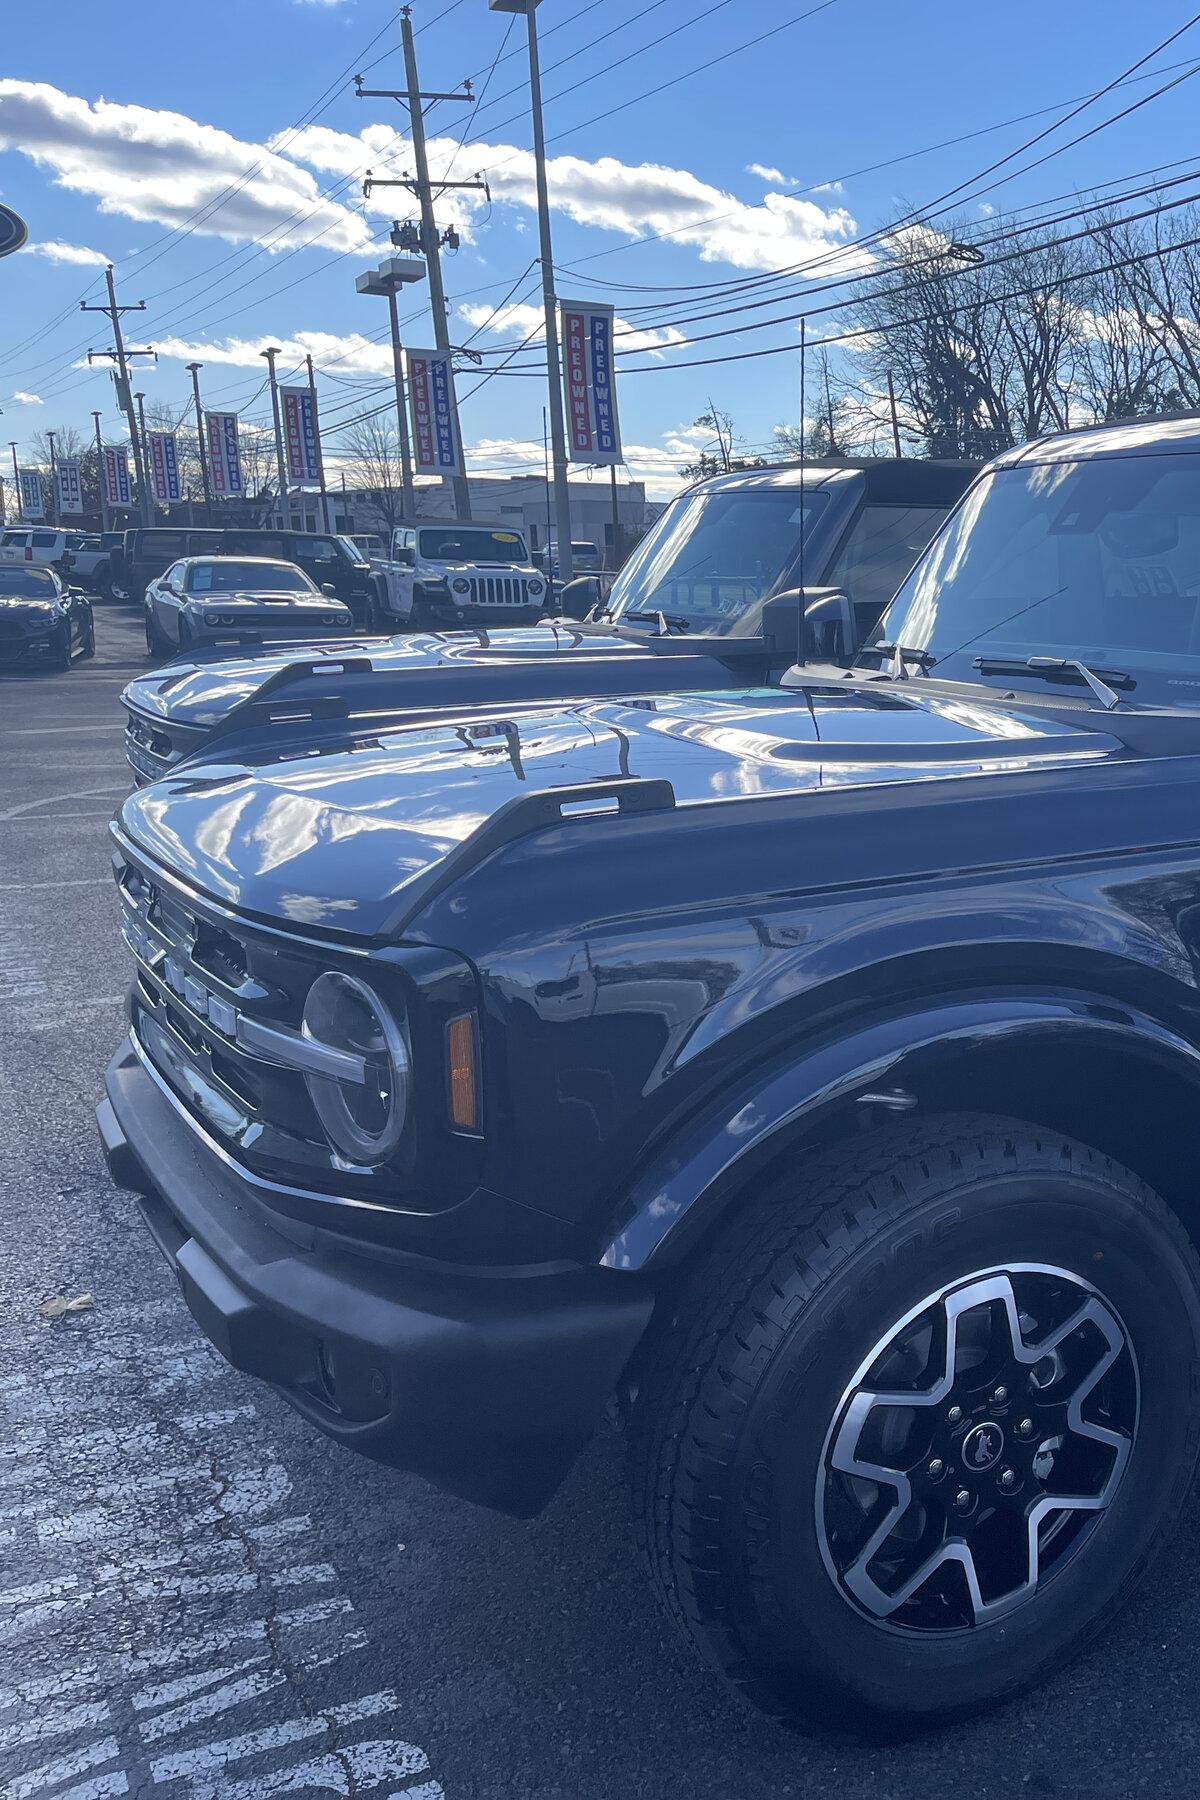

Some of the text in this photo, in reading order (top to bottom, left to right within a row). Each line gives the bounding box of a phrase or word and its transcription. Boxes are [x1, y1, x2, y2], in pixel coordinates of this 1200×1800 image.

[414, 363, 430, 462] PREOWNED
[435, 365, 450, 463] PREOWNED
[570, 319, 588, 446] PREOWNED
[595, 321, 612, 448] PREOWNED
